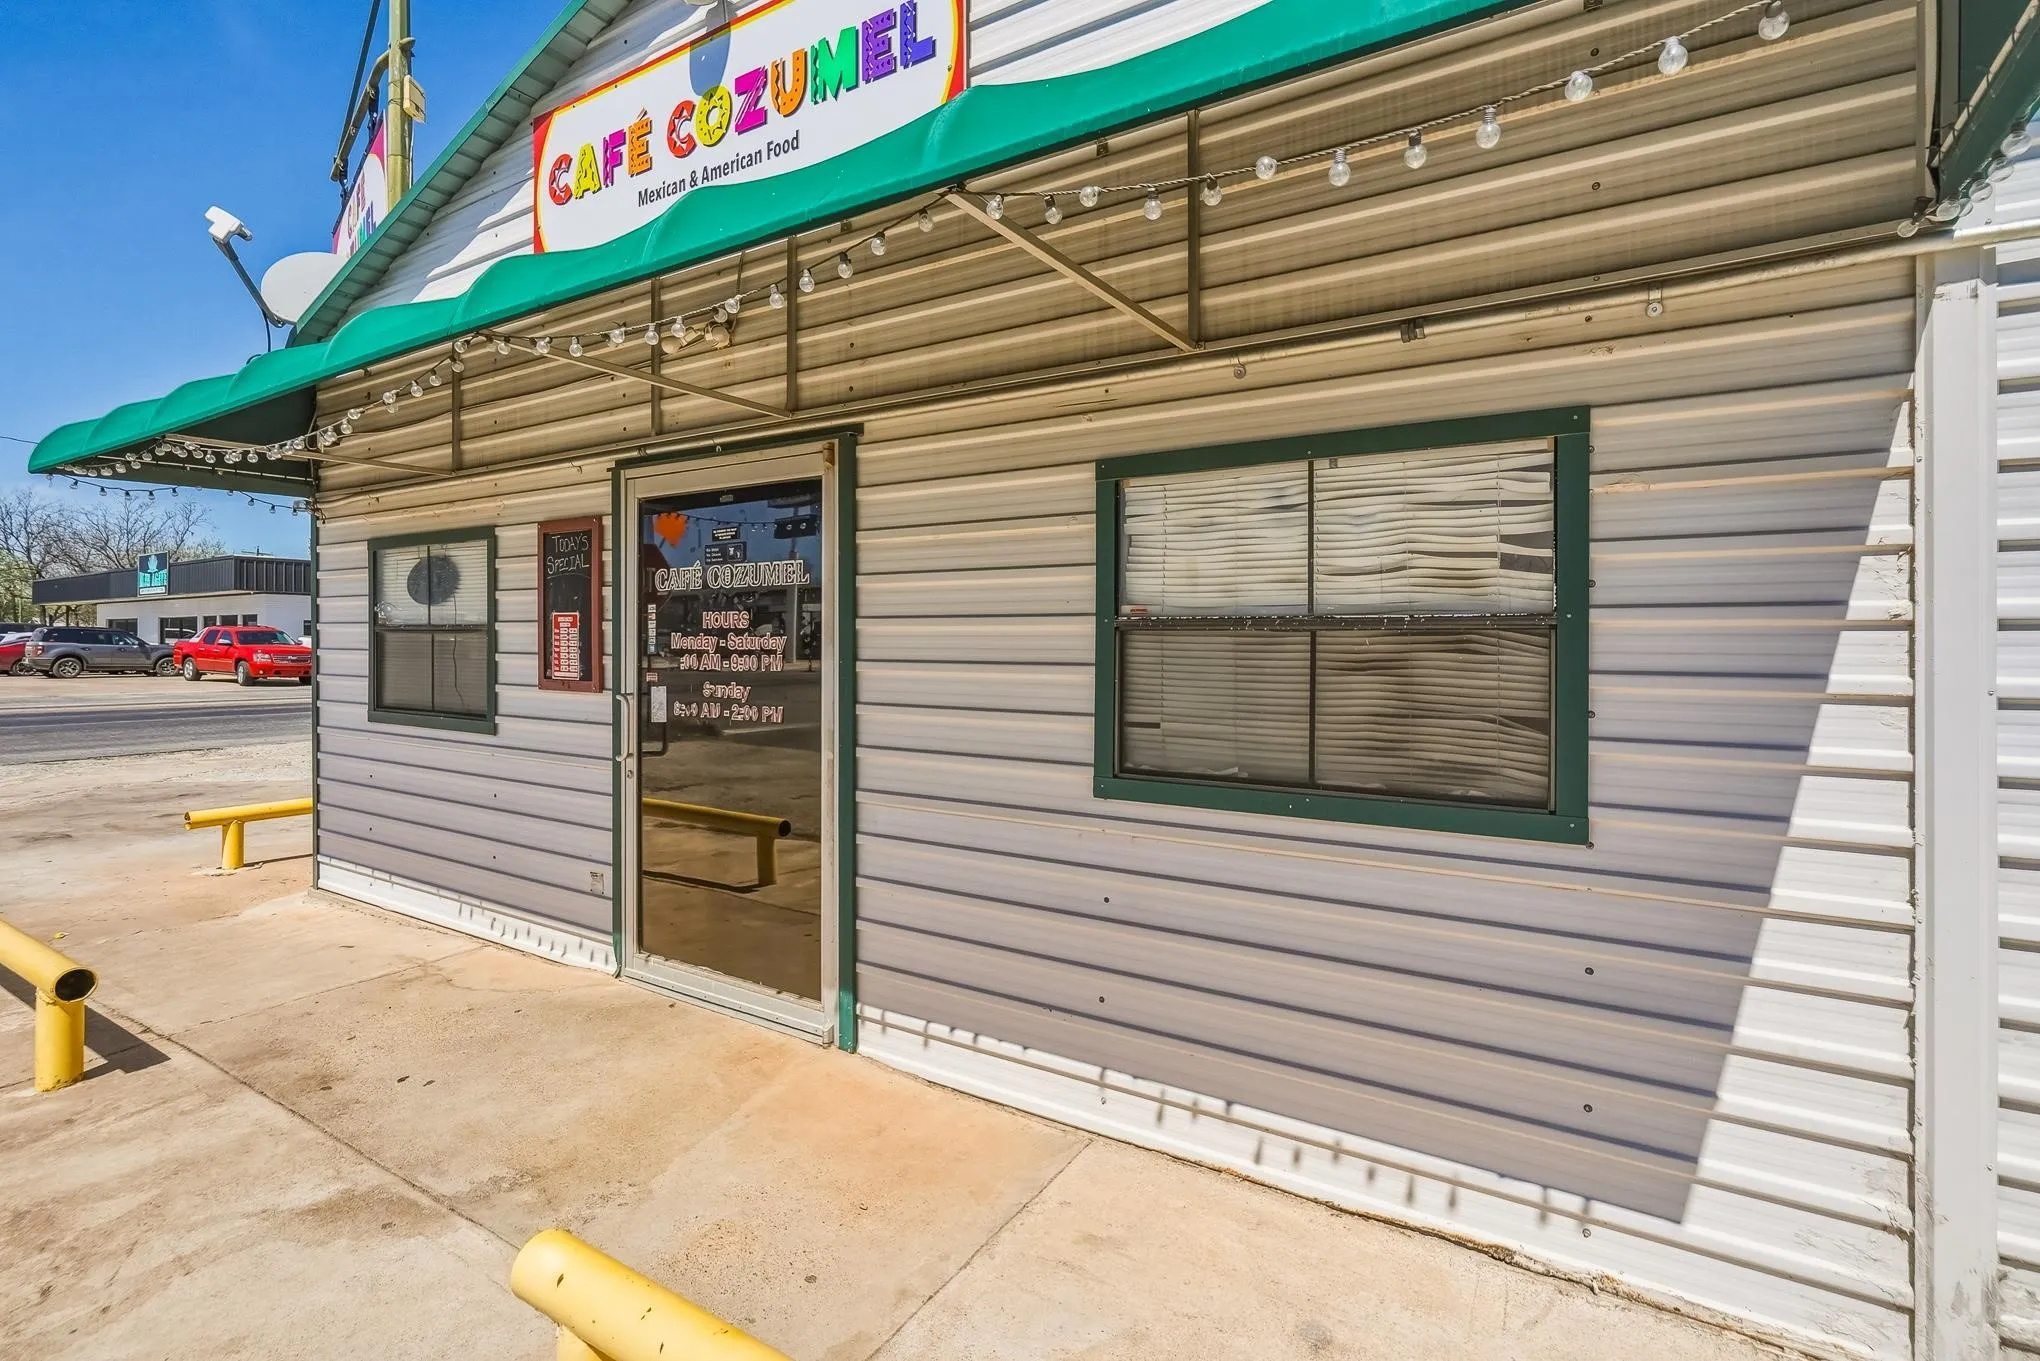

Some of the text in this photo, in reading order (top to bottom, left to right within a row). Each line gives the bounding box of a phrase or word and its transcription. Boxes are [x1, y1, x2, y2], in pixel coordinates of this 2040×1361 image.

[548, 0, 937, 206] CAFÉ COZUMEL
[638, 130, 800, 207] Mexican & American Food
[546, 554, 590, 574] SPECIAL
[655, 560, 702, 592] CAFÉ
[707, 560, 809, 589] COZUMEL
[702, 611, 749, 629] HOURS
[671, 632, 718, 652] Monday
[727, 632, 787, 653] Saturday
[700, 654, 721, 671] AM
[730, 654, 758, 672] 9:00
[761, 655, 784, 672] PM
[702, 681, 751, 703] Sunday
[700, 702, 721, 718] AM
[731, 704, 759, 721] 2:00
[761, 706, 784, 723] PM
